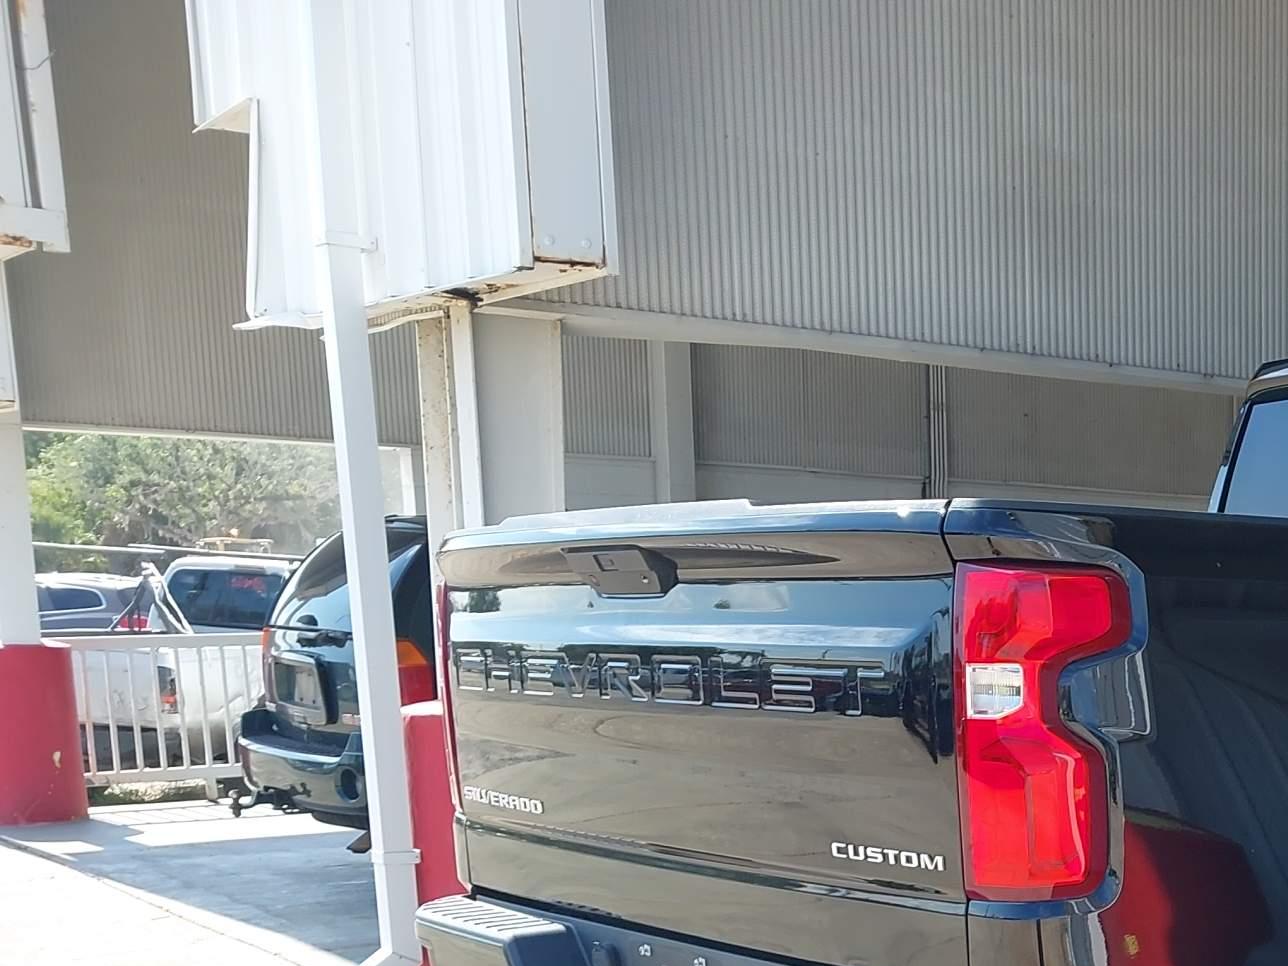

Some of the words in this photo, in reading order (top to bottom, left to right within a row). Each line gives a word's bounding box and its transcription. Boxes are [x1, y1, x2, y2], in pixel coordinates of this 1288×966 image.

[455, 645, 885, 717] CHEVROLET
[463, 785, 544, 815] SILVERADO
[830, 840, 946, 873] CUSTOM
